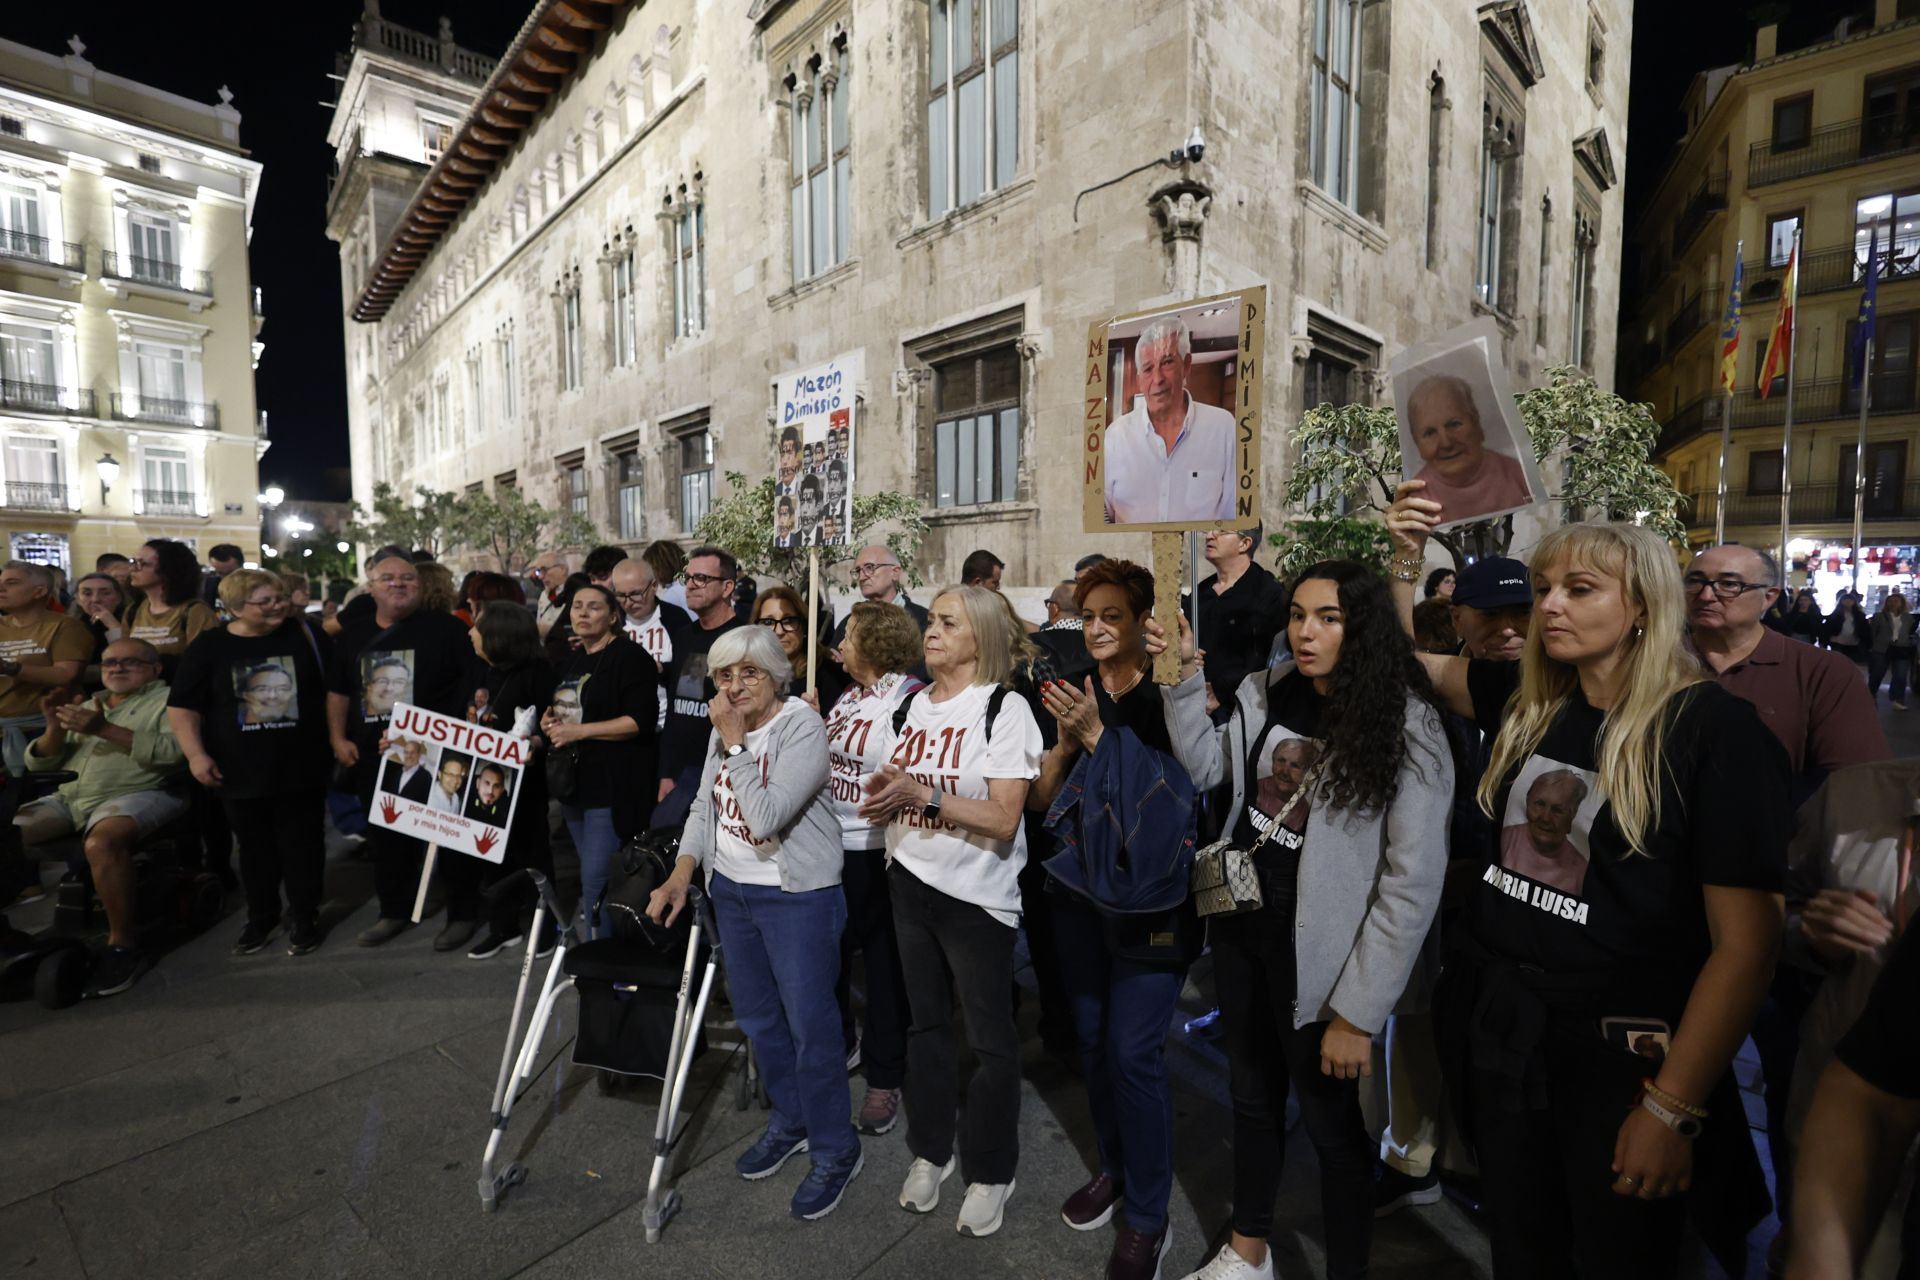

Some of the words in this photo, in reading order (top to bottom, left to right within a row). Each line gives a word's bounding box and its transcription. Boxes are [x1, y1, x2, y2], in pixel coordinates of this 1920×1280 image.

[794, 363, 842, 399] Mazón
[784, 388, 842, 424] Dimissió
[1086, 336, 1104, 485] MAZÓN
[673, 698, 709, 718] ANOLO
[394, 709, 523, 765] JUSTICIA
[889, 725, 968, 769] 20:11
[408, 803, 424, 813] por
[426, 808, 438, 818] mi
[439, 812, 471, 829] marido
[413, 817, 419, 826] y
[420, 820, 437, 832] mis
[438, 824, 461, 838] hijos
[1530, 886, 1590, 926] LUISA
